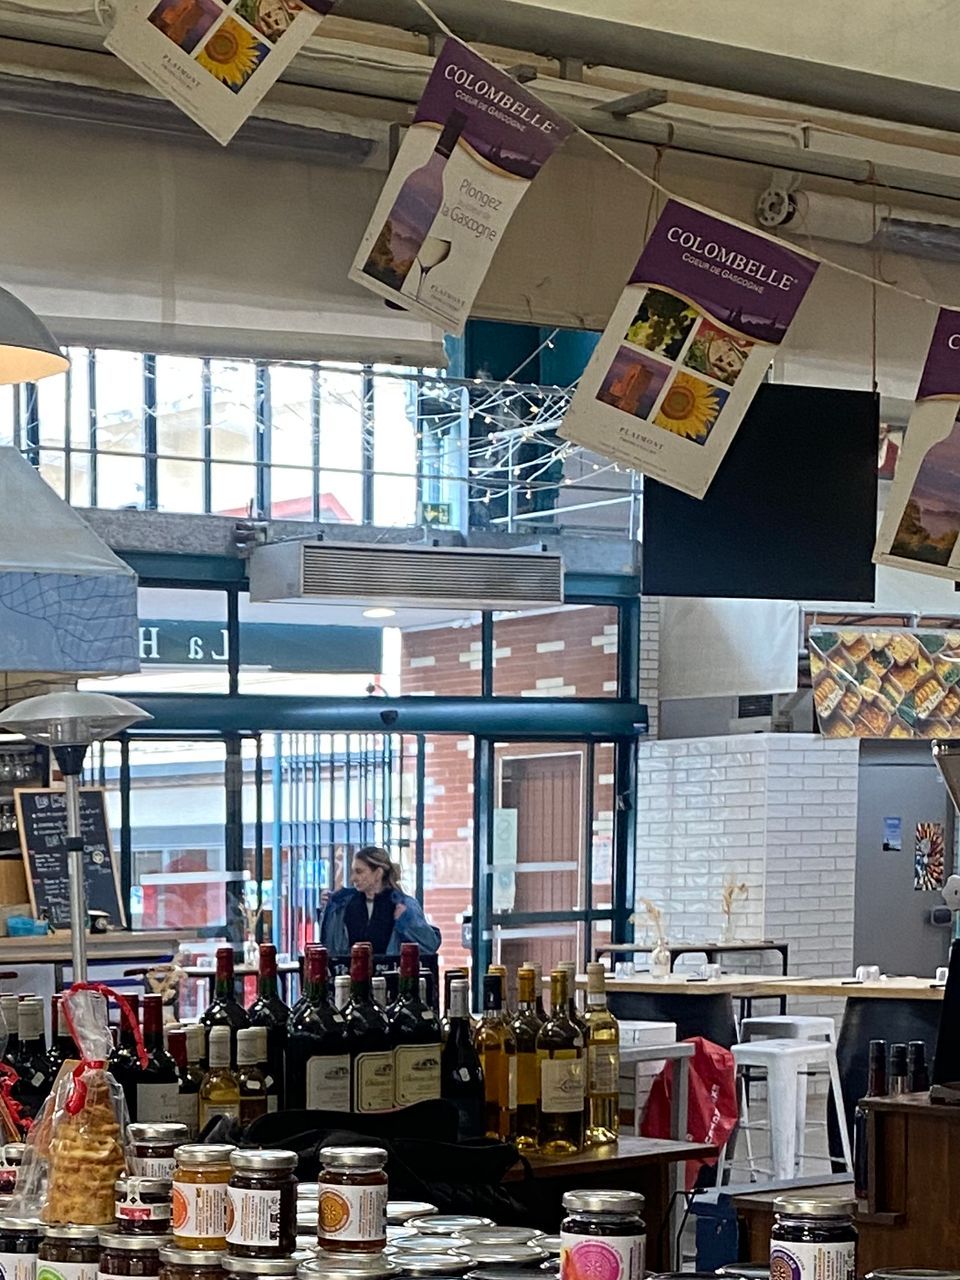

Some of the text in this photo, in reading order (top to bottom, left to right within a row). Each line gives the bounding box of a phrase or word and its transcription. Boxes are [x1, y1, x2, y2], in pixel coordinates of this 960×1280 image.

[488, 106, 527, 132] GASCOGNE
[459, 178, 502, 211] Plongez
[450, 206, 497, 241] Gascogne
[710, 265, 721, 276] DE
[721, 269, 765, 295] GASCOGNE
